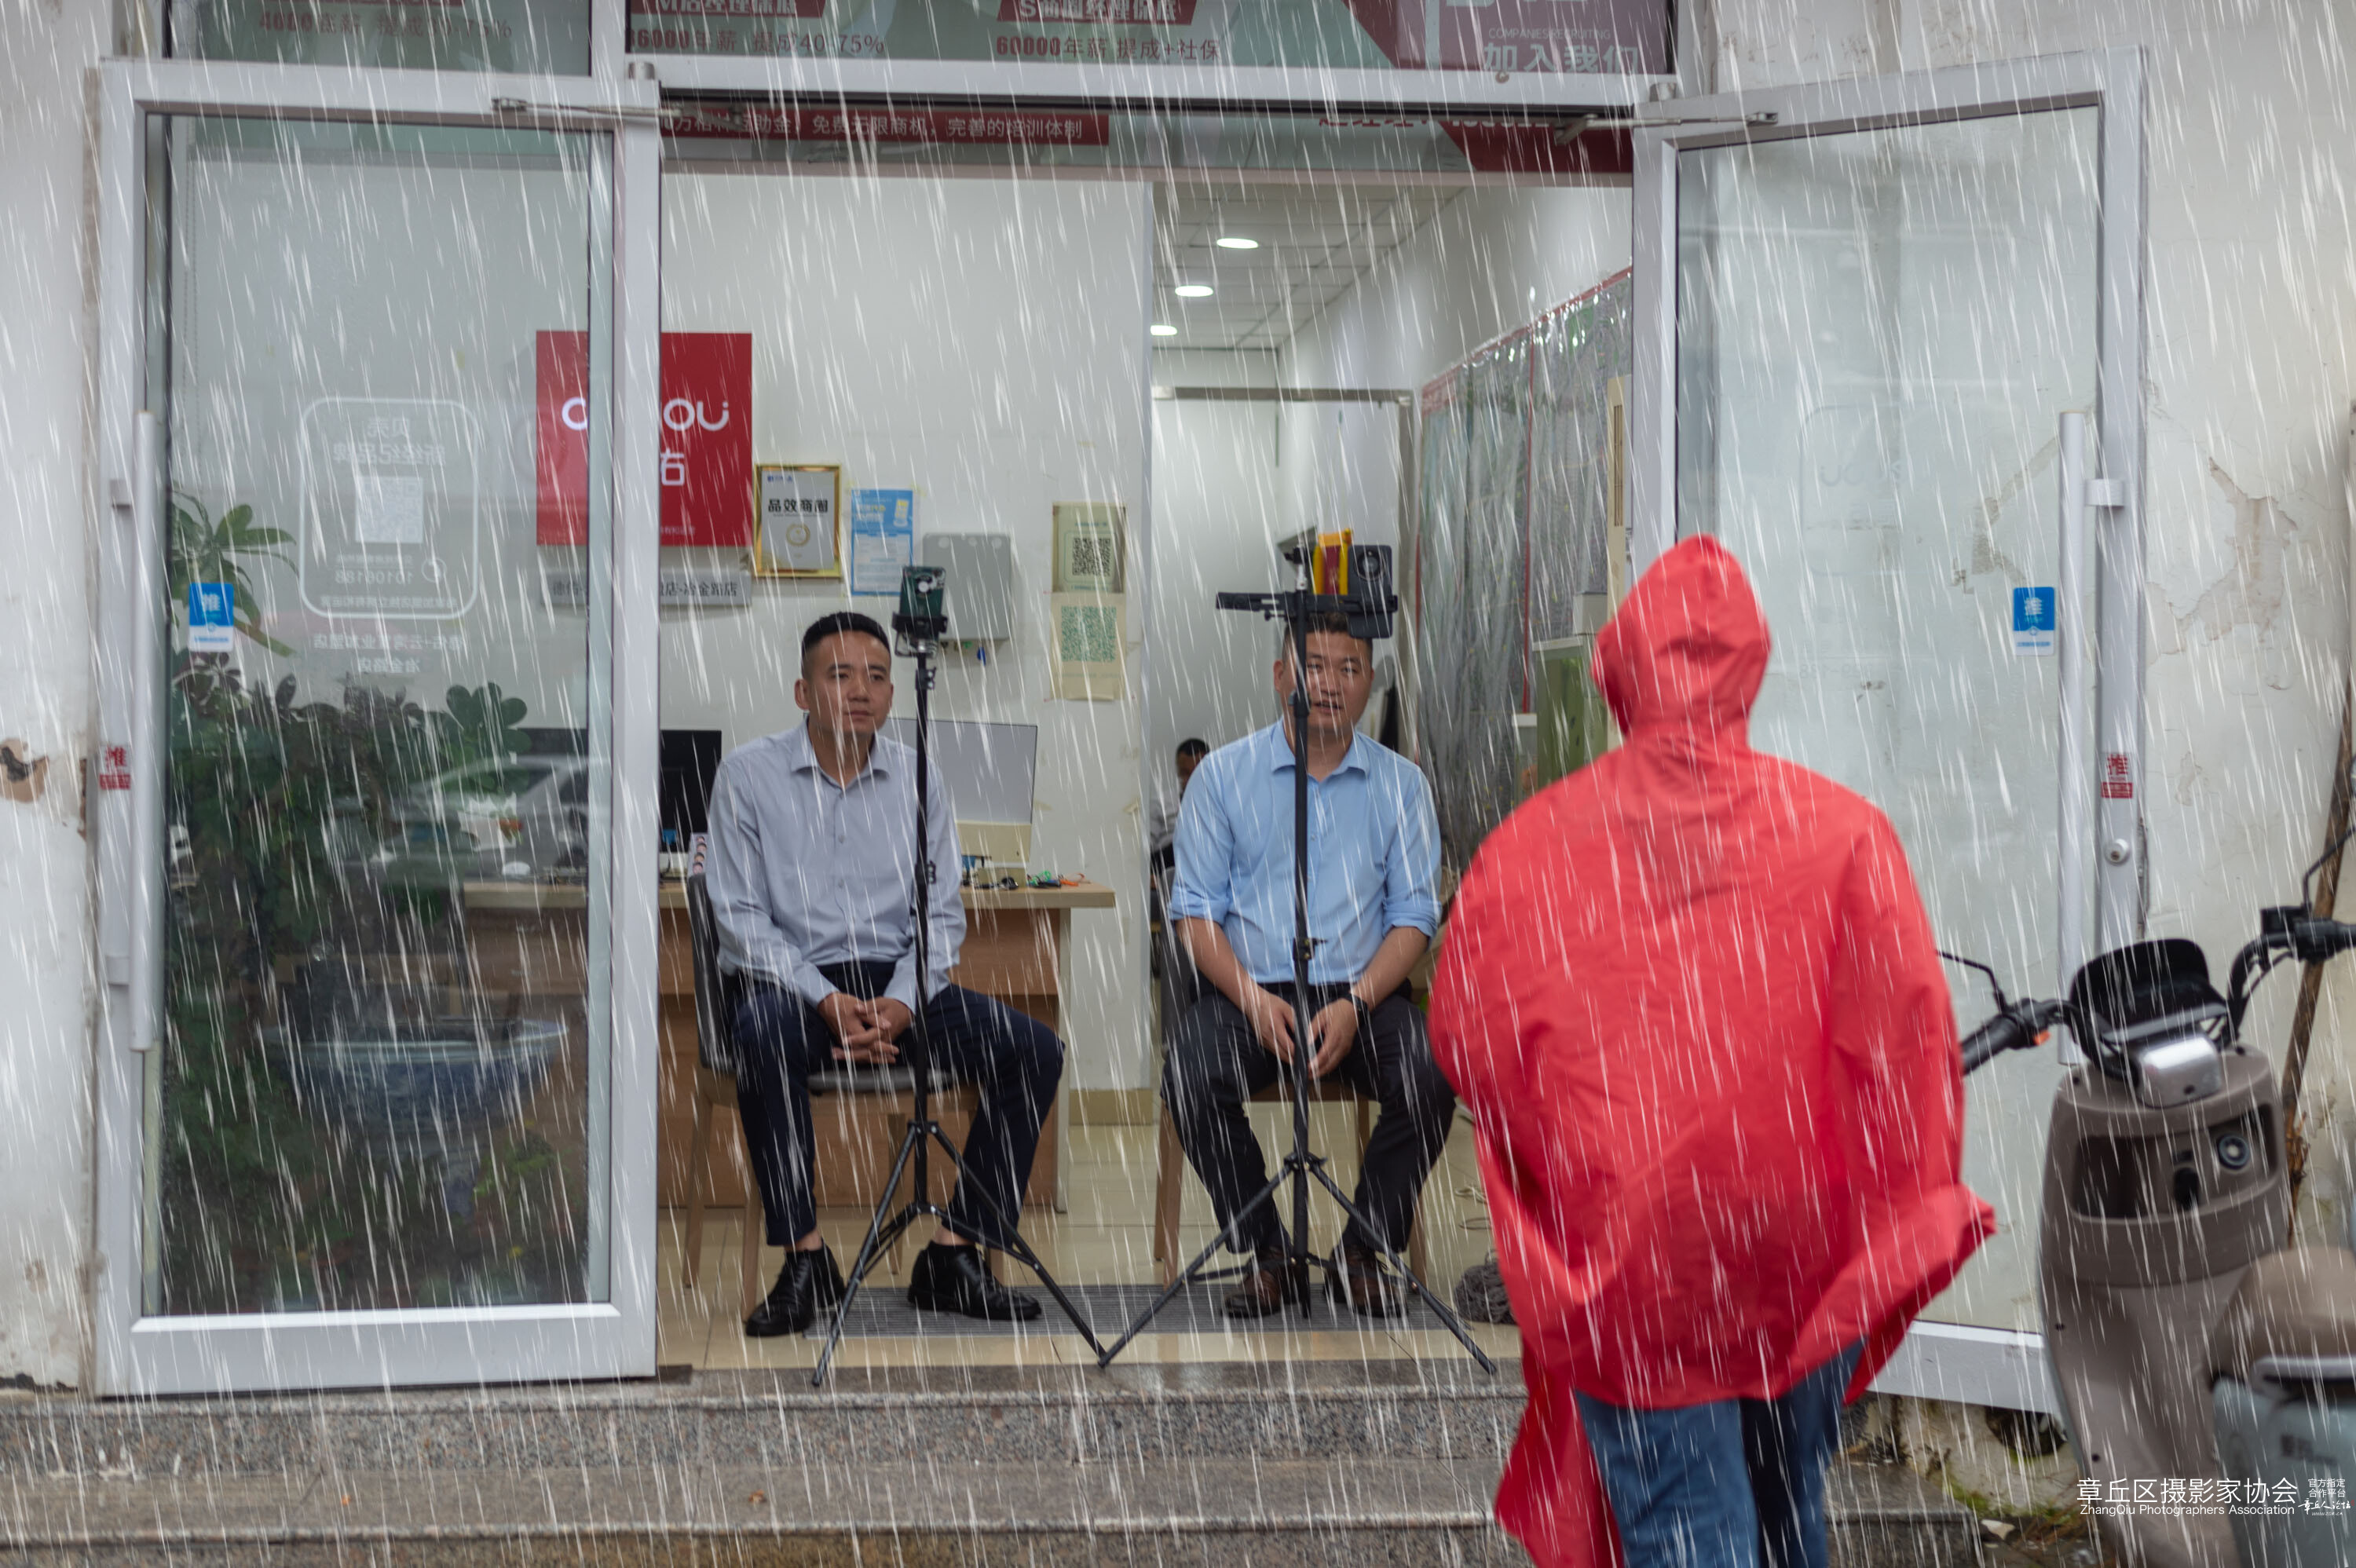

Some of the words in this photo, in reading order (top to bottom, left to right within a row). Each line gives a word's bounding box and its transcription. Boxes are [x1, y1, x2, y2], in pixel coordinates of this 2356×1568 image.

[1488, 28, 1547, 40] COMPANIES
[1483, 42, 1638, 72] 加入我们
